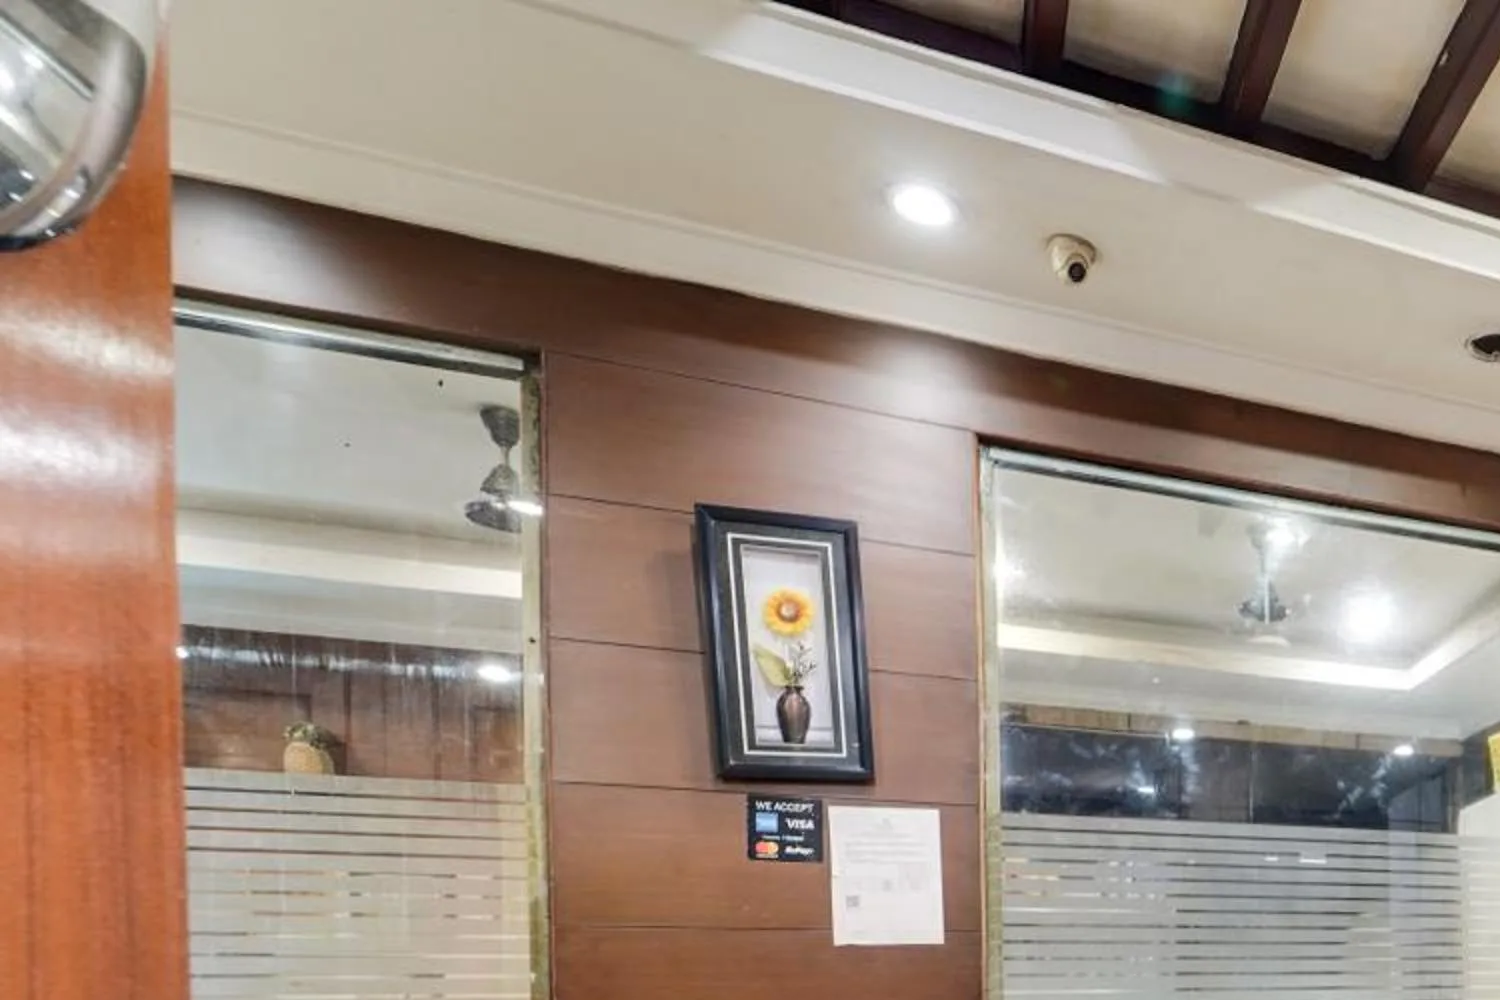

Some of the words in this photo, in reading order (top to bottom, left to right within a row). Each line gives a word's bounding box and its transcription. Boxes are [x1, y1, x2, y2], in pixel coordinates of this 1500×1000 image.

[756, 800, 773, 811] WE
[774, 801, 815, 814] ACCEPT
[785, 818, 815, 830] VISA
